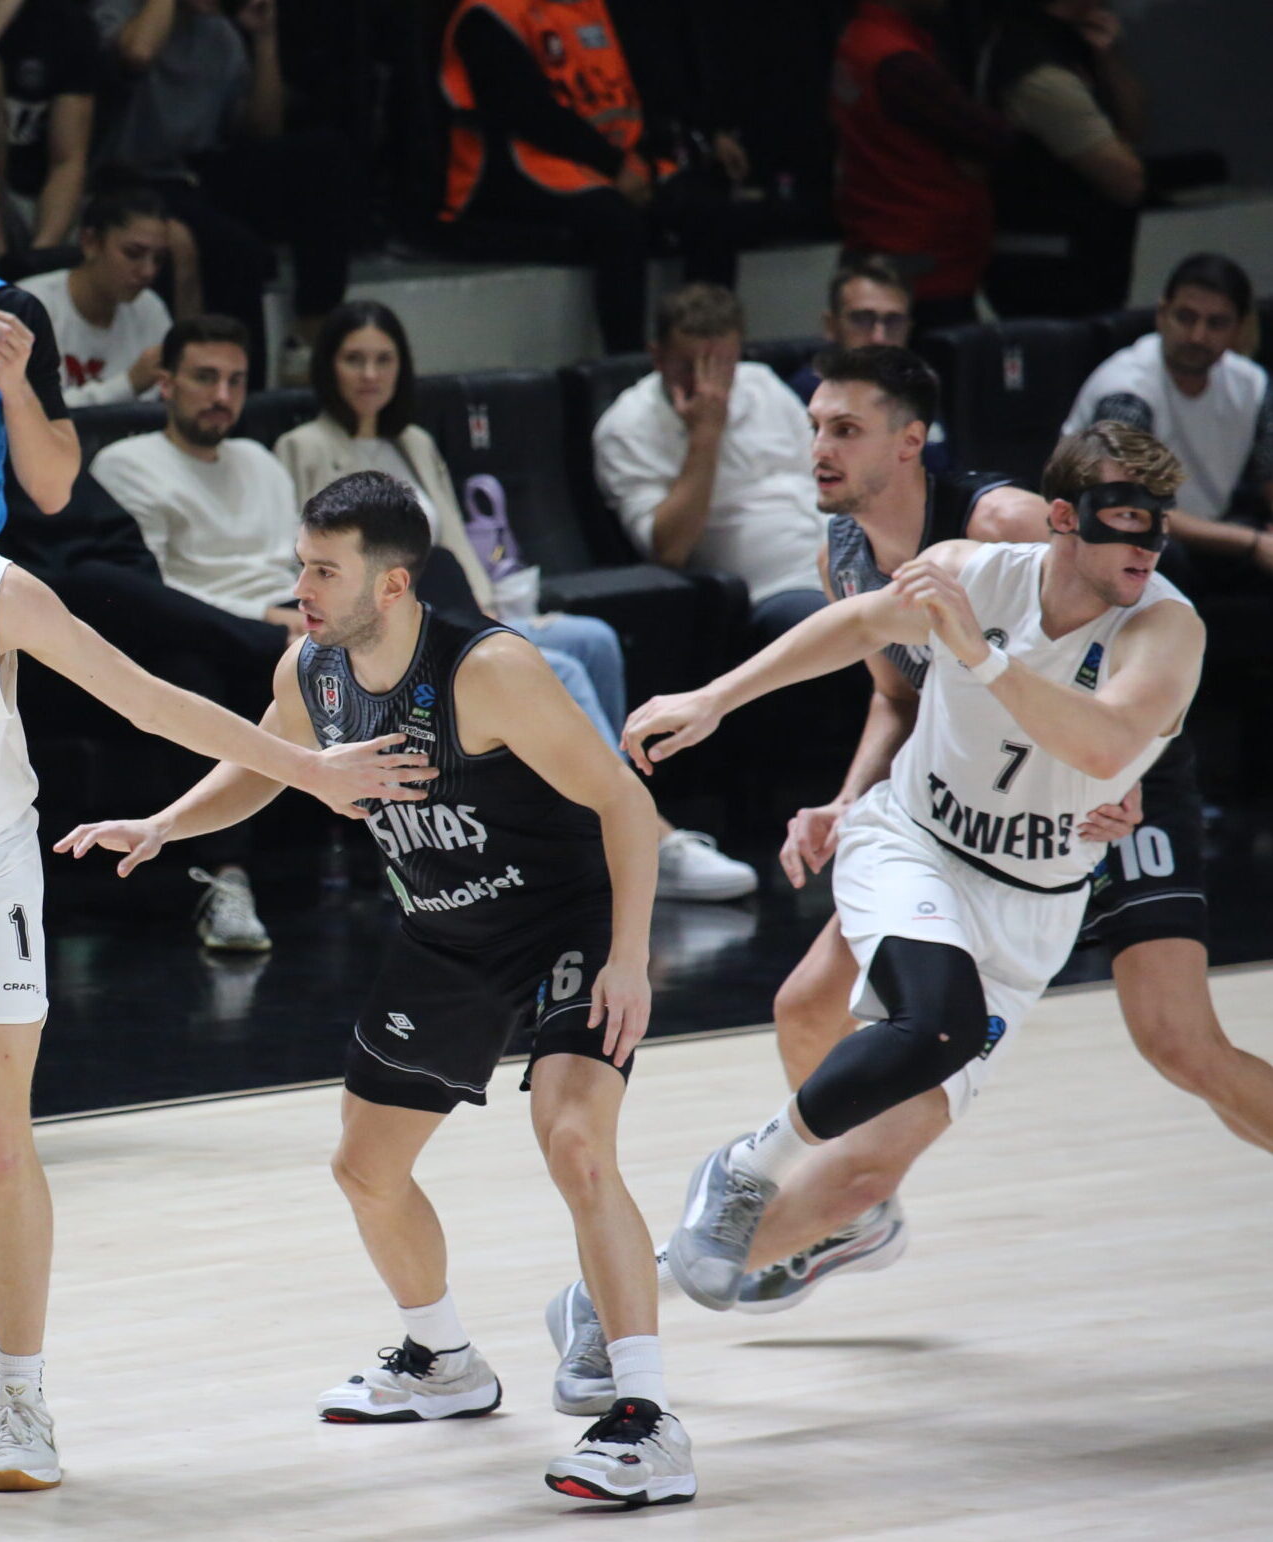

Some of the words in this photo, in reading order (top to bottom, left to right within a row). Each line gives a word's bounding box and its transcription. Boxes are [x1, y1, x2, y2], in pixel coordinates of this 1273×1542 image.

[992, 739, 1033, 794] 7
[927, 772, 1074, 861] TOWERS
[1110, 825, 1175, 881] 10
[413, 864, 525, 912] emlakjet
[8, 903, 31, 961] 1
[3, 982, 36, 992] CRAFT
[551, 950, 584, 1001] 6
